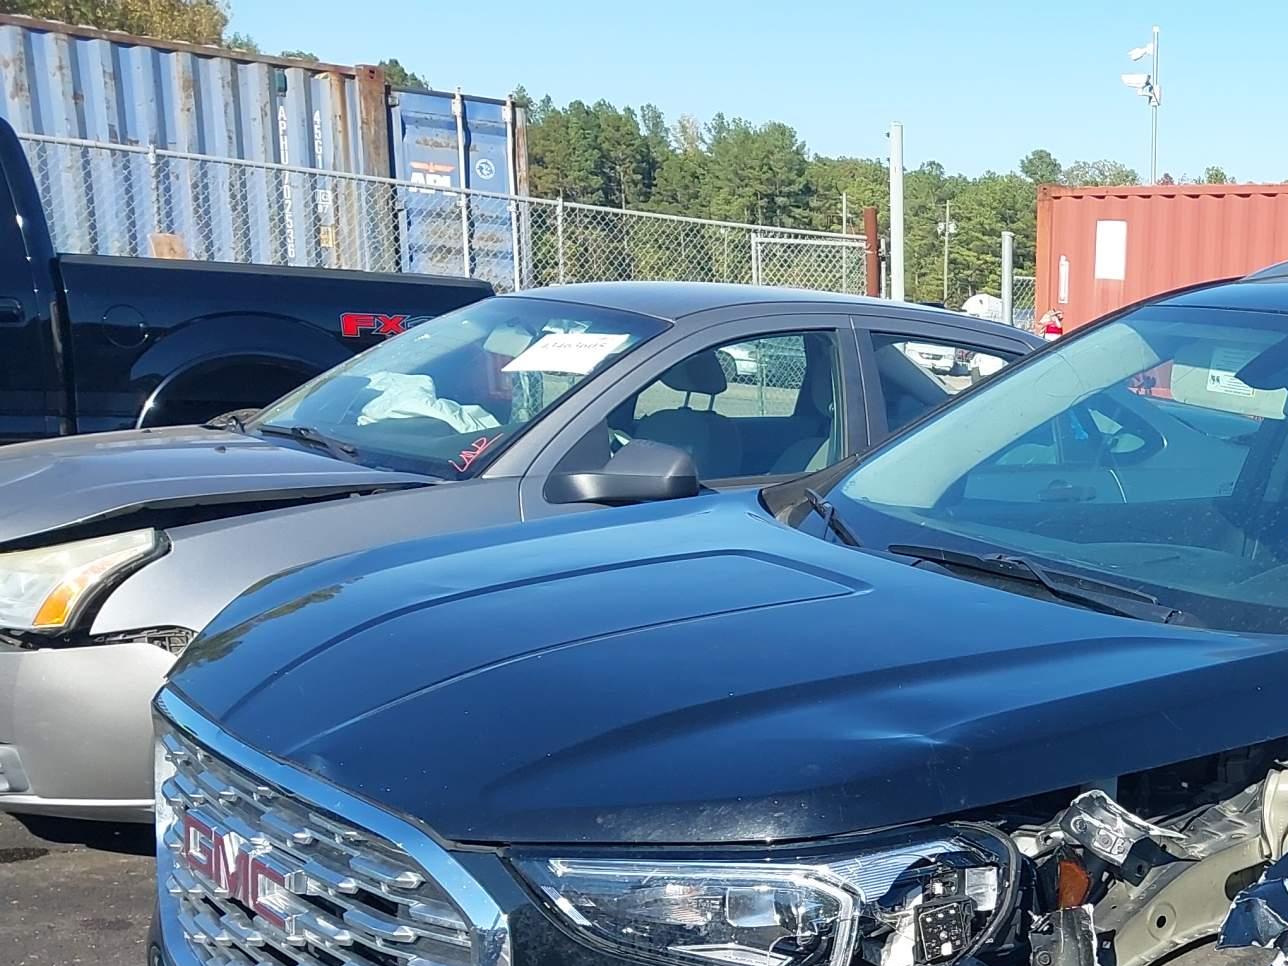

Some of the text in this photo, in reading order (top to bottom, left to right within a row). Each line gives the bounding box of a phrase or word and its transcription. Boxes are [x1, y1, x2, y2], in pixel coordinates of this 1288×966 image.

[277, 105, 289, 165] APHU
[313, 110, 324, 169] 45G1
[184, 809, 304, 933] GMC
